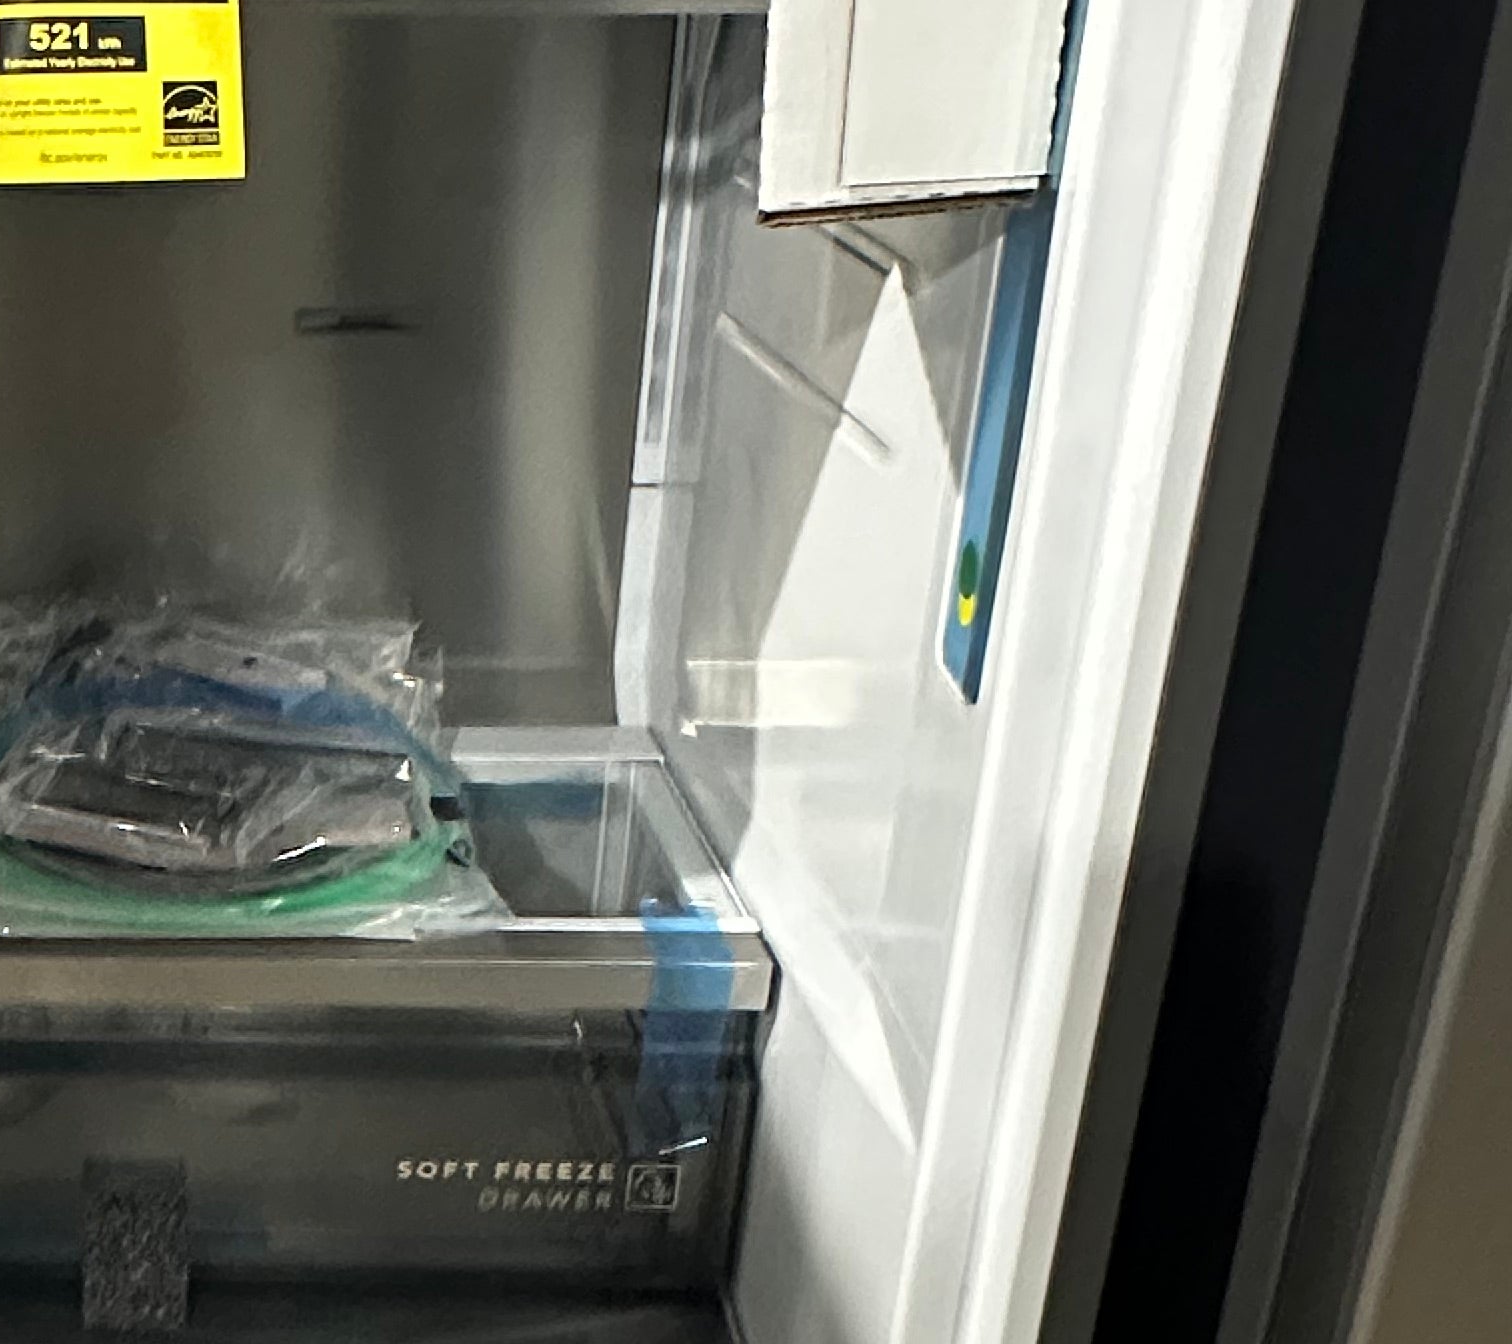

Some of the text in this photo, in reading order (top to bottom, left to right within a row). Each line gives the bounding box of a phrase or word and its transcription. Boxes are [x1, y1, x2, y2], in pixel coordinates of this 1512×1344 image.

[29, 22, 88, 51] 521
[396, 1159, 616, 1182] SOFT FREEZE
[477, 1186, 612, 1213] DRAWER
